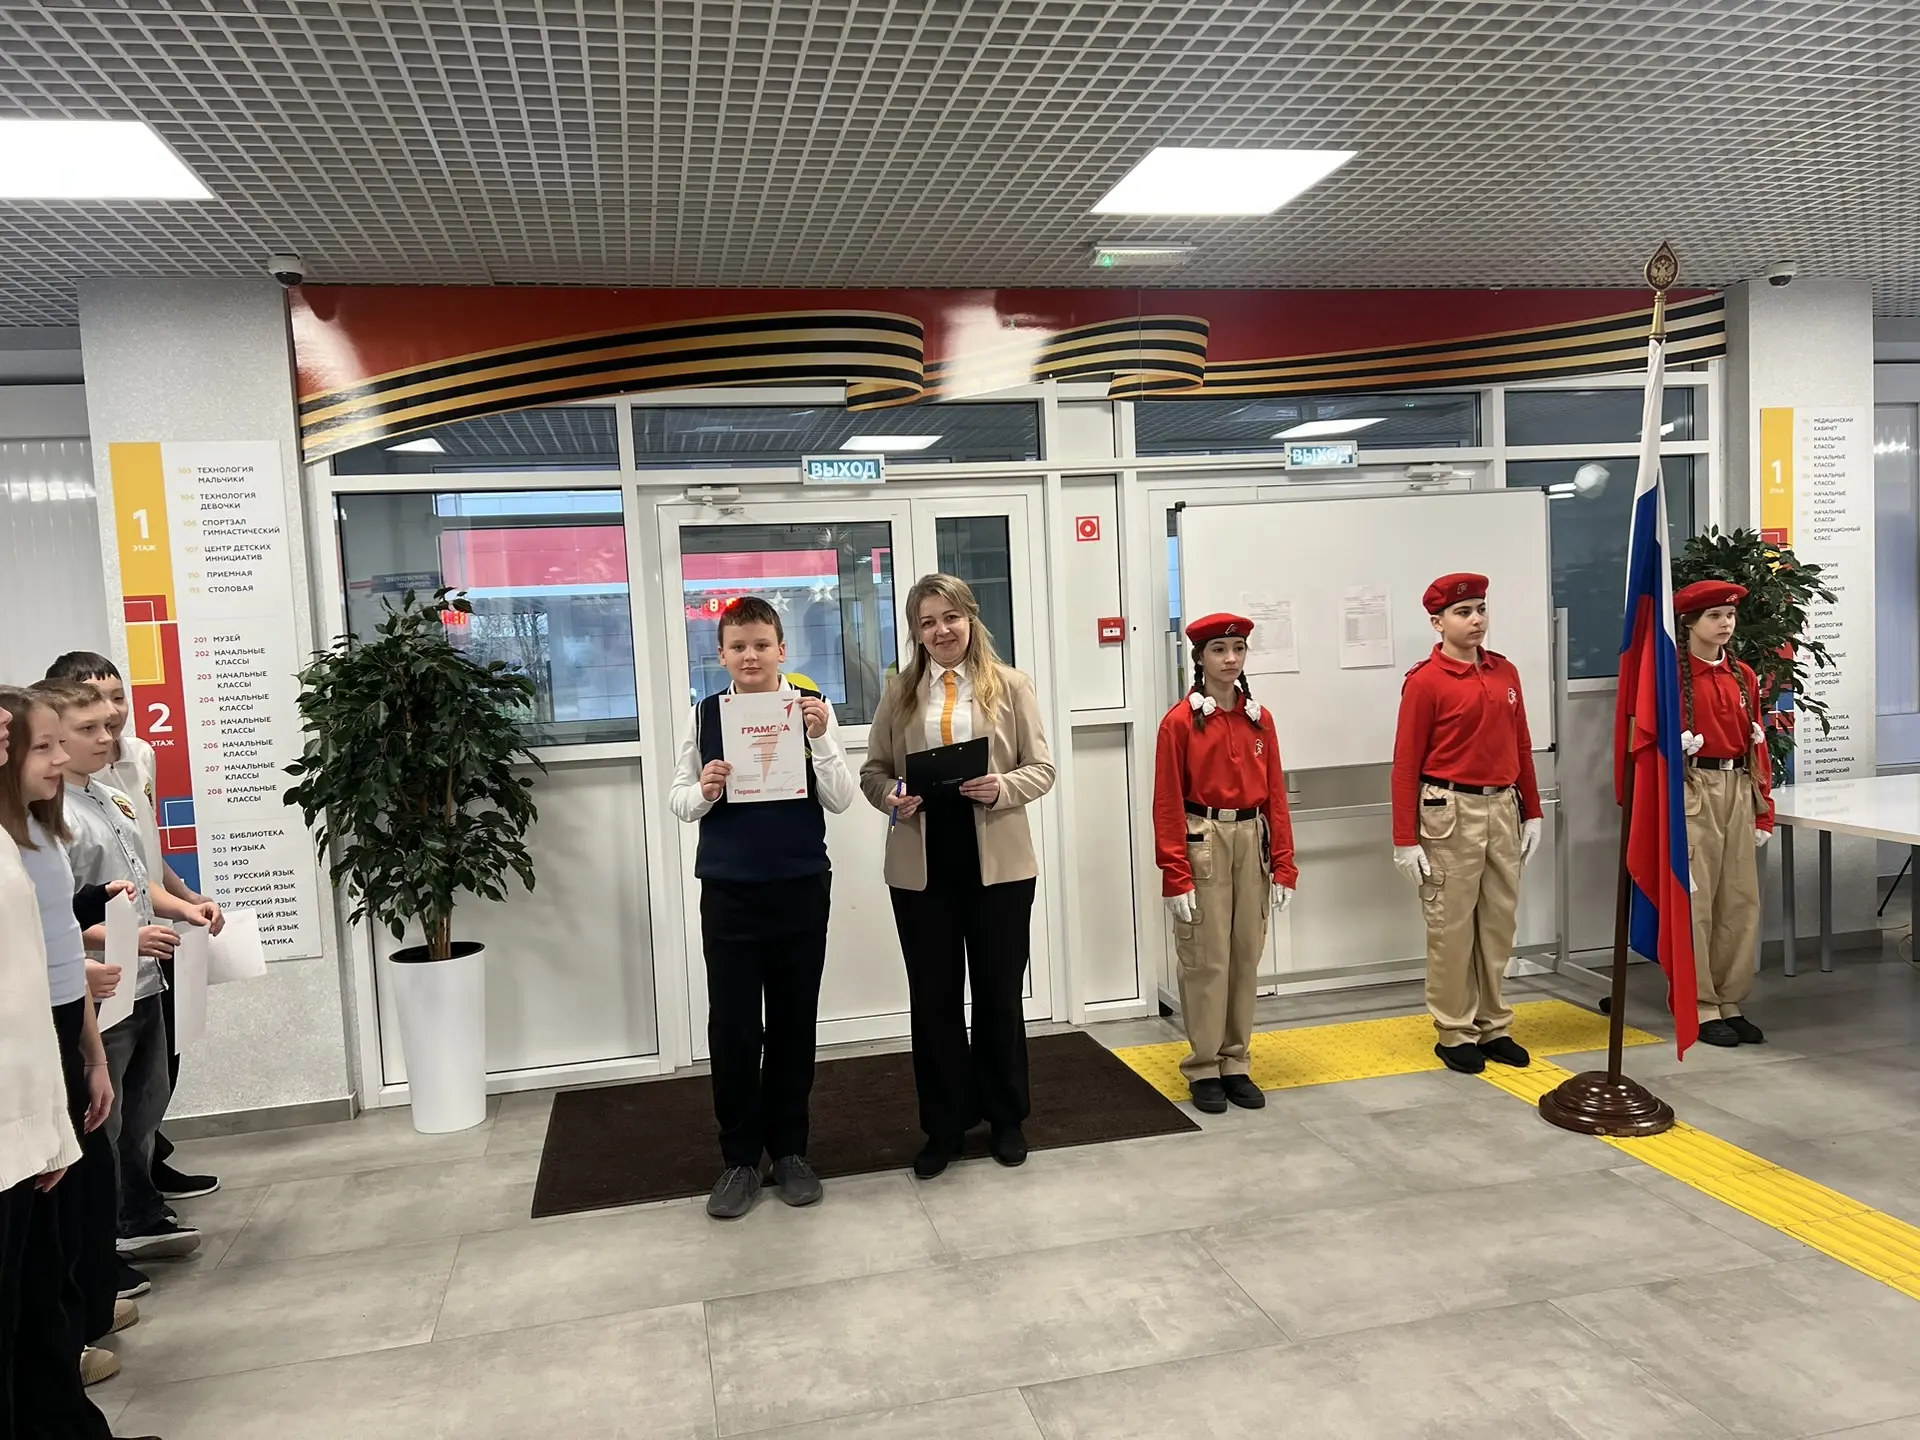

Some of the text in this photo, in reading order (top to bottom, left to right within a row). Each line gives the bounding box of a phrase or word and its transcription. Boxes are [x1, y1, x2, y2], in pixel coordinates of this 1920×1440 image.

[1292, 448, 1349, 463] ВЫХОД
[197, 466, 254, 474] ТЕХНОЛОГИЯ
[811, 461, 876, 480] ВЫХОД
[1771, 459, 1781, 483] 1
[200, 492, 256, 500] ТЕХНОЛОГИЯ
[133, 508, 149, 539] 1
[203, 526, 280, 536] ГИМНАСТИЧЕСКИЙ
[233, 544, 272, 552] ДЕТСКИХ
[205, 554, 263, 562] ИННИЦИАТИВ
[206, 570, 253, 578] ПРИЕМНАЯ
[208, 585, 254, 593] СТОЛОВАЯ
[213, 634, 241, 642] МУЗЕЙ
[214, 648, 266, 656] НАЧАЛЬНЫЕ
[215, 658, 250, 666] КЛАССЫ
[216, 671, 268, 679] НАЧАЛЬНЫЕ
[217, 681, 252, 689] КЛАССЫ
[218, 694, 270, 702] НАЧАЛЬНЫЕ
[219, 704, 254, 712] КЛАССЫ
[148, 702, 173, 732] 2
[220, 717, 272, 725] НАЧАЛЬНЫЕ
[221, 727, 256, 735] КЛАССЫ
[222, 739, 274, 748] НАЧАЛЬНЫЕ
[223, 750, 258, 758] КЛАССЫ
[224, 762, 275, 771] НАЧАЛЬНЫЕ
[1815, 767, 1850, 775] АНГЛИЙСКИЙ
[225, 773, 260, 781] КЛАССЫ
[226, 785, 277, 794] НАЧАЛЬНЫЕ
[227, 795, 262, 803] КЛАССЫ
[229, 830, 285, 839] БИБЛИОТЕКА
[231, 844, 266, 852] МУЗЫКА
[233, 870, 270, 880] РУССКИЙ
[272, 869, 295, 877] ЯЗЫК
[234, 884, 272, 894] РУССКИЙ
[236, 897, 273, 907] РУССКИЙ
[275, 910, 298, 918] ЯЗЫК
[277, 923, 300, 931] ЯЗЫК
[261, 937, 294, 946] МАТИКА
